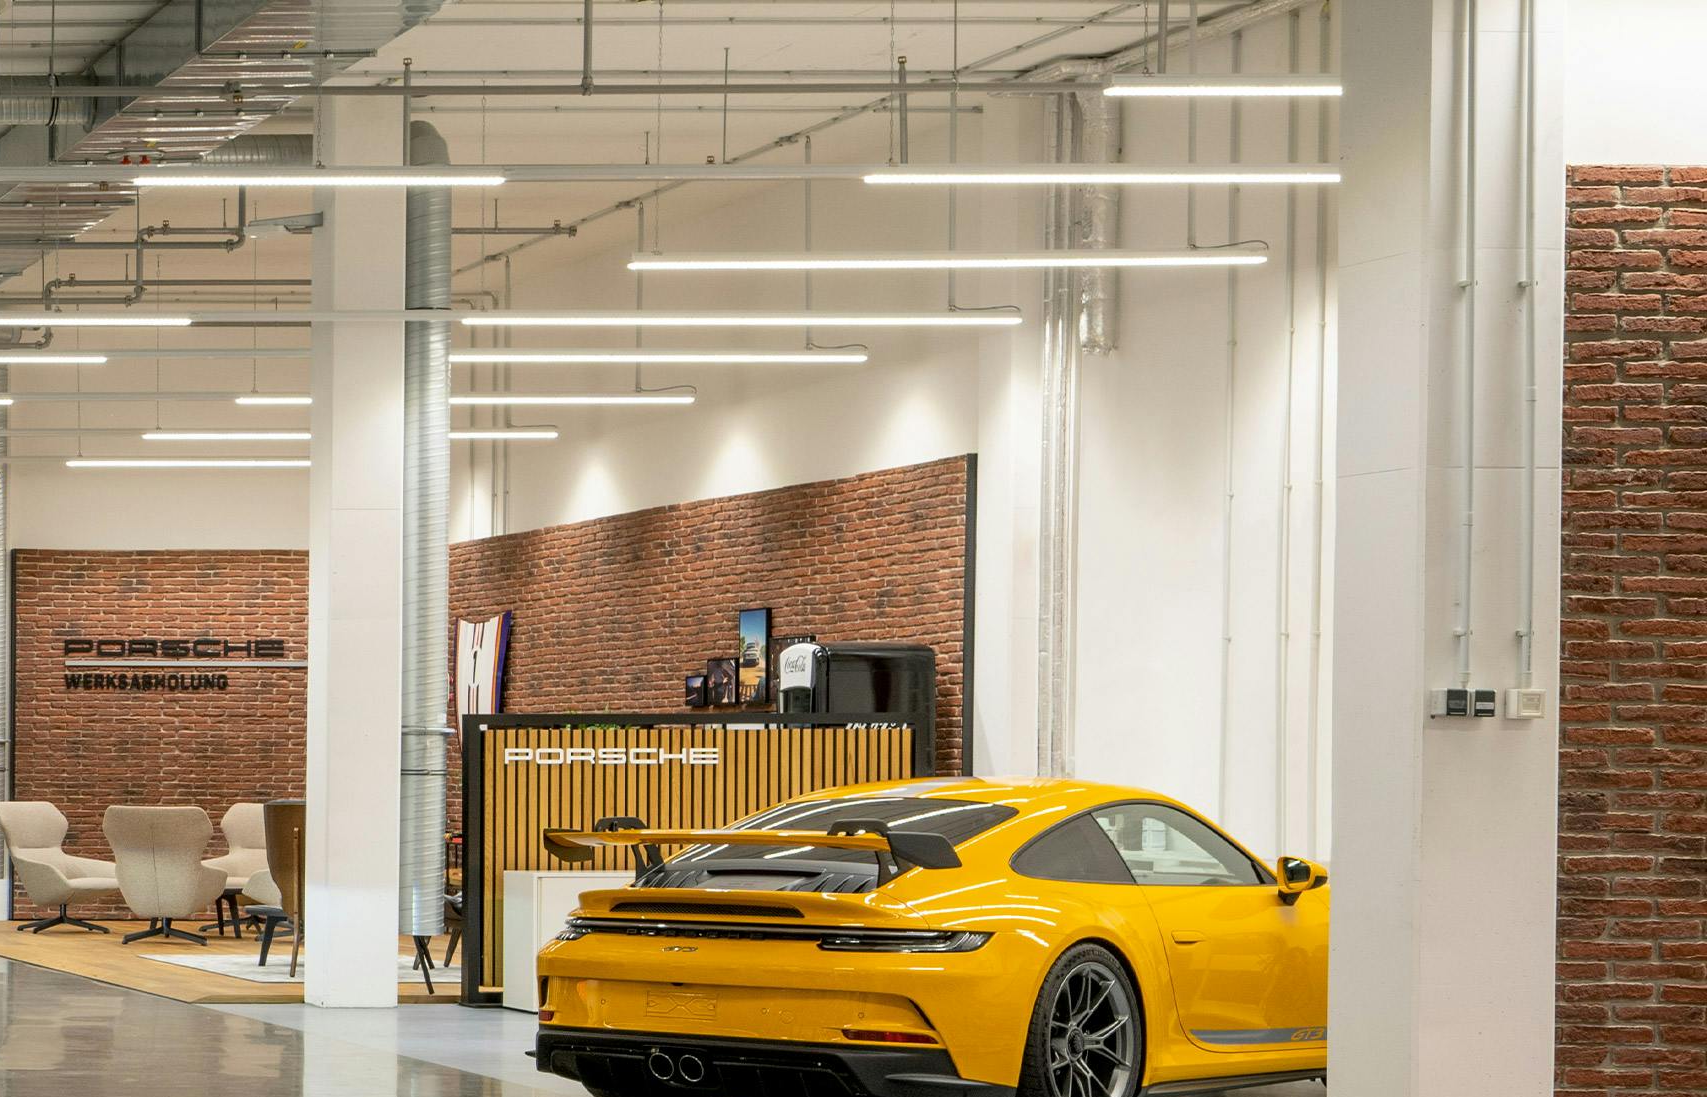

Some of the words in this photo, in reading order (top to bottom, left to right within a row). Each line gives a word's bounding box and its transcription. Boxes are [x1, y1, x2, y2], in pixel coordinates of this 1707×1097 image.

[64, 639, 285, 658] PORSCHE
[64, 673, 229, 691] WERKSABHOLUNG
[504, 747, 719, 765] PORSCHE
